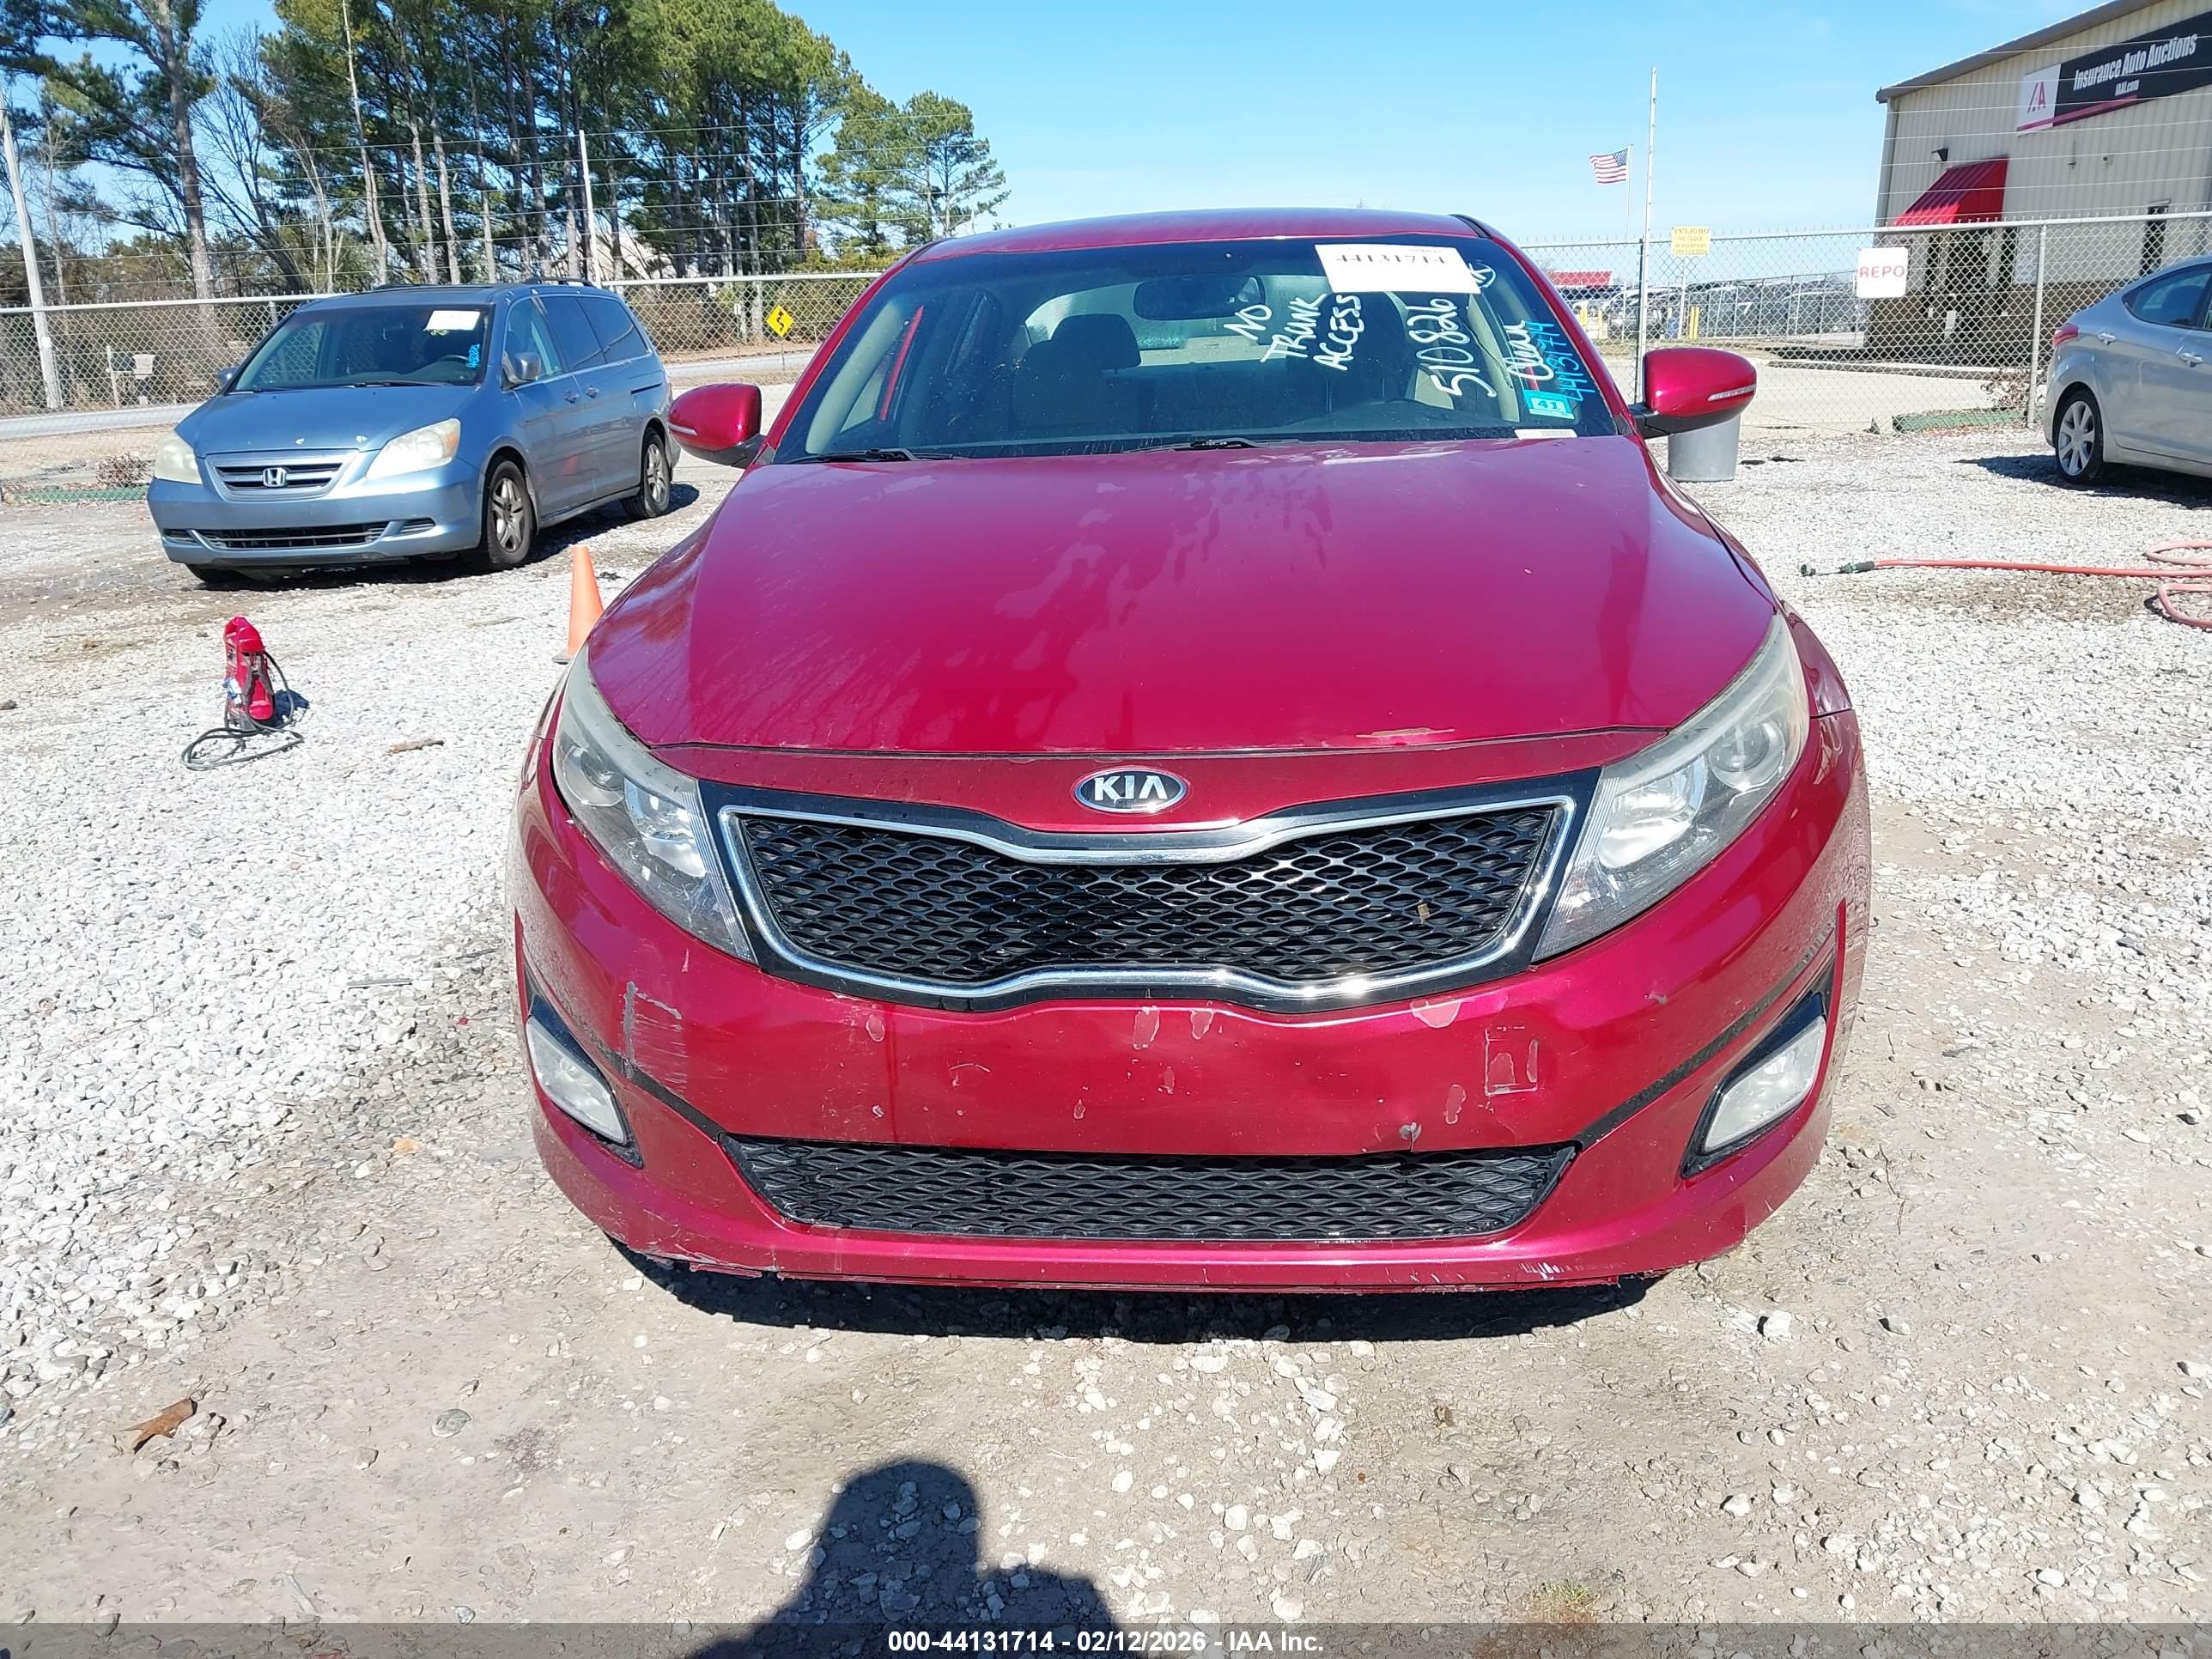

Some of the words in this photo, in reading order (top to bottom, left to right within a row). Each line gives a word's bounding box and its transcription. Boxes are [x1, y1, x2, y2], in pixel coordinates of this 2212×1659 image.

[2073, 58, 2123, 91] Insurance
[2122, 50, 2147, 76] Auto
[2147, 33, 2198, 67] Auctions
[1859, 265, 1905, 278] REPO
[1224, 304, 1273, 340] NO
[1259, 293, 1328, 362] TRUNK
[1313, 295, 1364, 371] ACCESS
[1094, 775, 1168, 801] KIA
